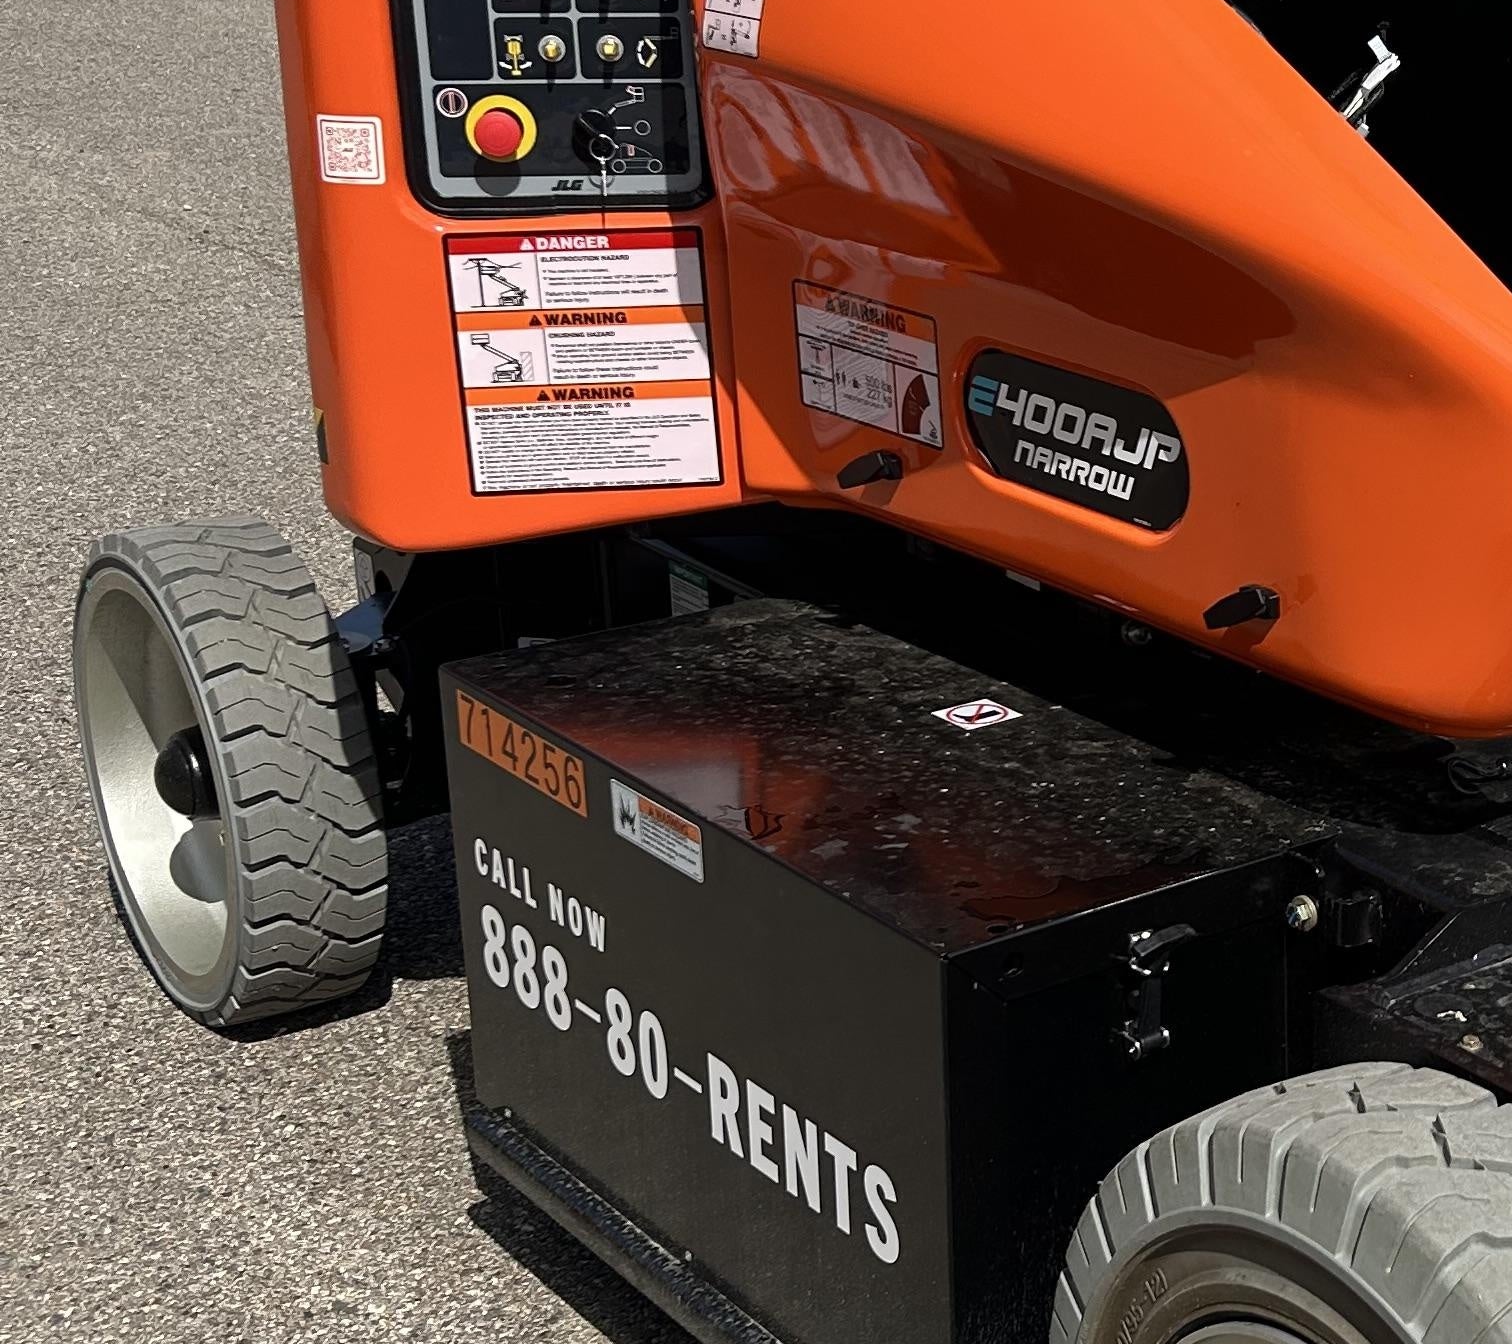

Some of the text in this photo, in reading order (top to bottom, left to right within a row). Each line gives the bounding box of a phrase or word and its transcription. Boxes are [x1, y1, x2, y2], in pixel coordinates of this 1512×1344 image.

[552, 179, 584, 191] JLG
[535, 236, 609, 251] DANGER
[544, 312, 627, 326] WARNING
[838, 298, 907, 334] WARNING
[553, 387, 634, 401] WARNING
[967, 374, 1180, 470] E400AJP
[1014, 439, 1136, 501] NARROW
[461, 696, 582, 811] 714256
[474, 837, 608, 953] CALL NOW
[481, 903, 901, 1265] 888-80-RENTS
